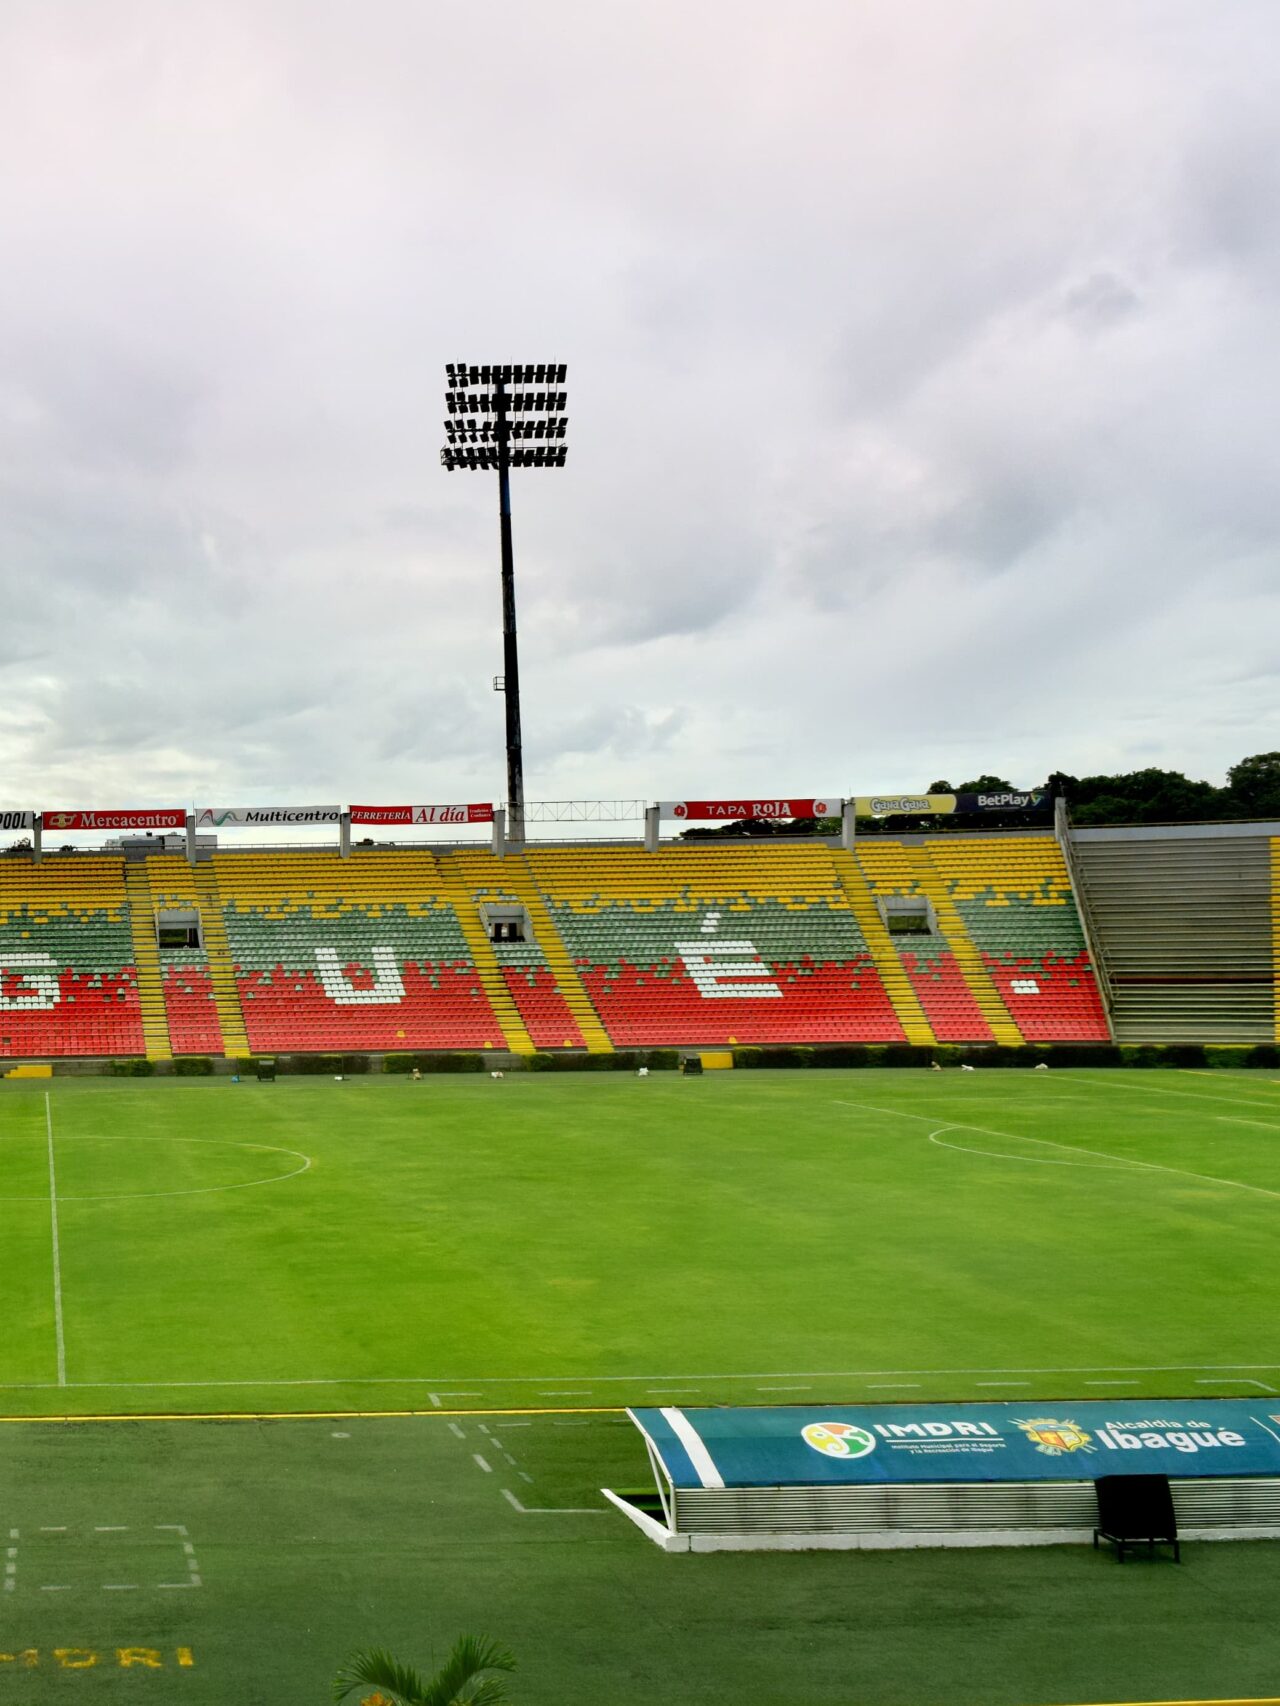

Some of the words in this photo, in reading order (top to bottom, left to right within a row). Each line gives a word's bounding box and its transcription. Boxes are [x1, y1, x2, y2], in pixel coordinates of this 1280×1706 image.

[978, 793, 1029, 808] BetPlay
[245, 810, 339, 823] Multicentro
[350, 809, 411, 820] FERRETERÍA
[415, 807, 436, 822] Al
[438, 807, 465, 822] día
[706, 805, 747, 815] TAPA
[752, 802, 792, 817] ROJA
[80, 812, 177, 827] Mercacentro
[872, 1421, 999, 1437] IMDRI
[1104, 1419, 1184, 1430] Alcaldía
[1186, 1419, 1212, 1428] de
[1094, 1427, 1247, 1453] Ibagué
